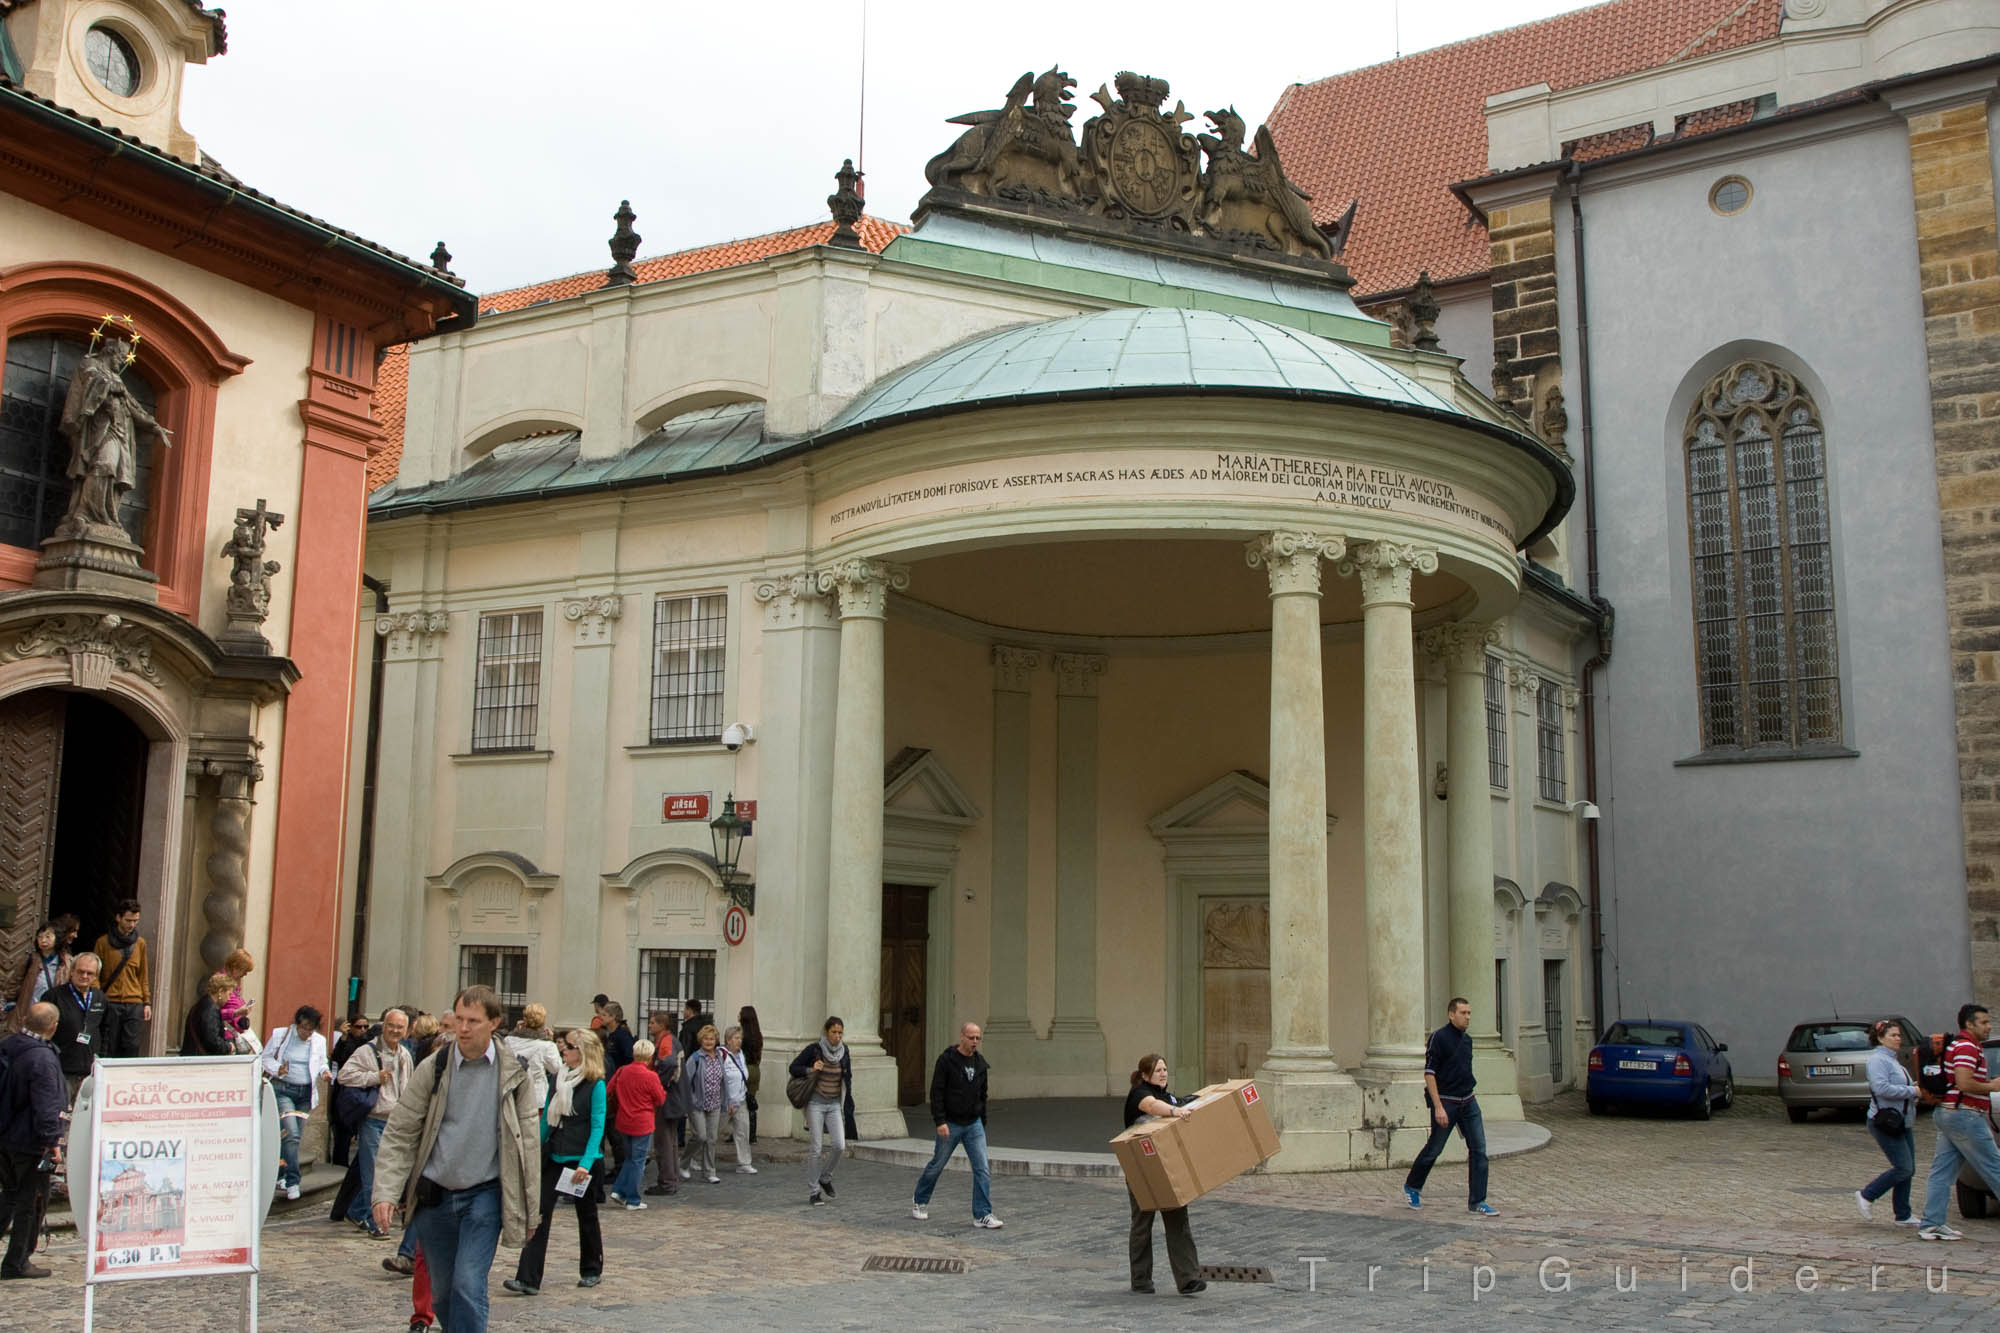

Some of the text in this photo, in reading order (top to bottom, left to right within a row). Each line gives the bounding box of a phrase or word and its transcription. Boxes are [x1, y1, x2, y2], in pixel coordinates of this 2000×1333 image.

[1218, 453, 1270, 471] MARIA
[1270, 457, 1343, 479] THERESIA
[1346, 463, 1367, 482] PIA
[1371, 469, 1406, 488] FELIX
[923, 483, 947, 499] DOMI
[949, 479, 999, 495] FORISQVE
[1003, 472, 1063, 488] ASSERTAM
[1066, 469, 1114, 482] SACRAS
[1118, 469, 1145, 480] HAS
[1189, 469, 1208, 480] AD
[1211, 467, 1268, 483] MAIOREM
[1271, 471, 1290, 485] DEI
[1346, 480, 1377, 495] DIVINI
[1380, 486, 1416, 502] CVLTVS
[1471, 509, 1480, 521] ET
[743, 802, 749, 811] 2
[131, 1081, 168, 1093] Castle
[113, 1088, 248, 1106] GALA CONCERT
[108, 1140, 182, 1159] TODAY
[108, 1248, 141, 1265] 6.30
